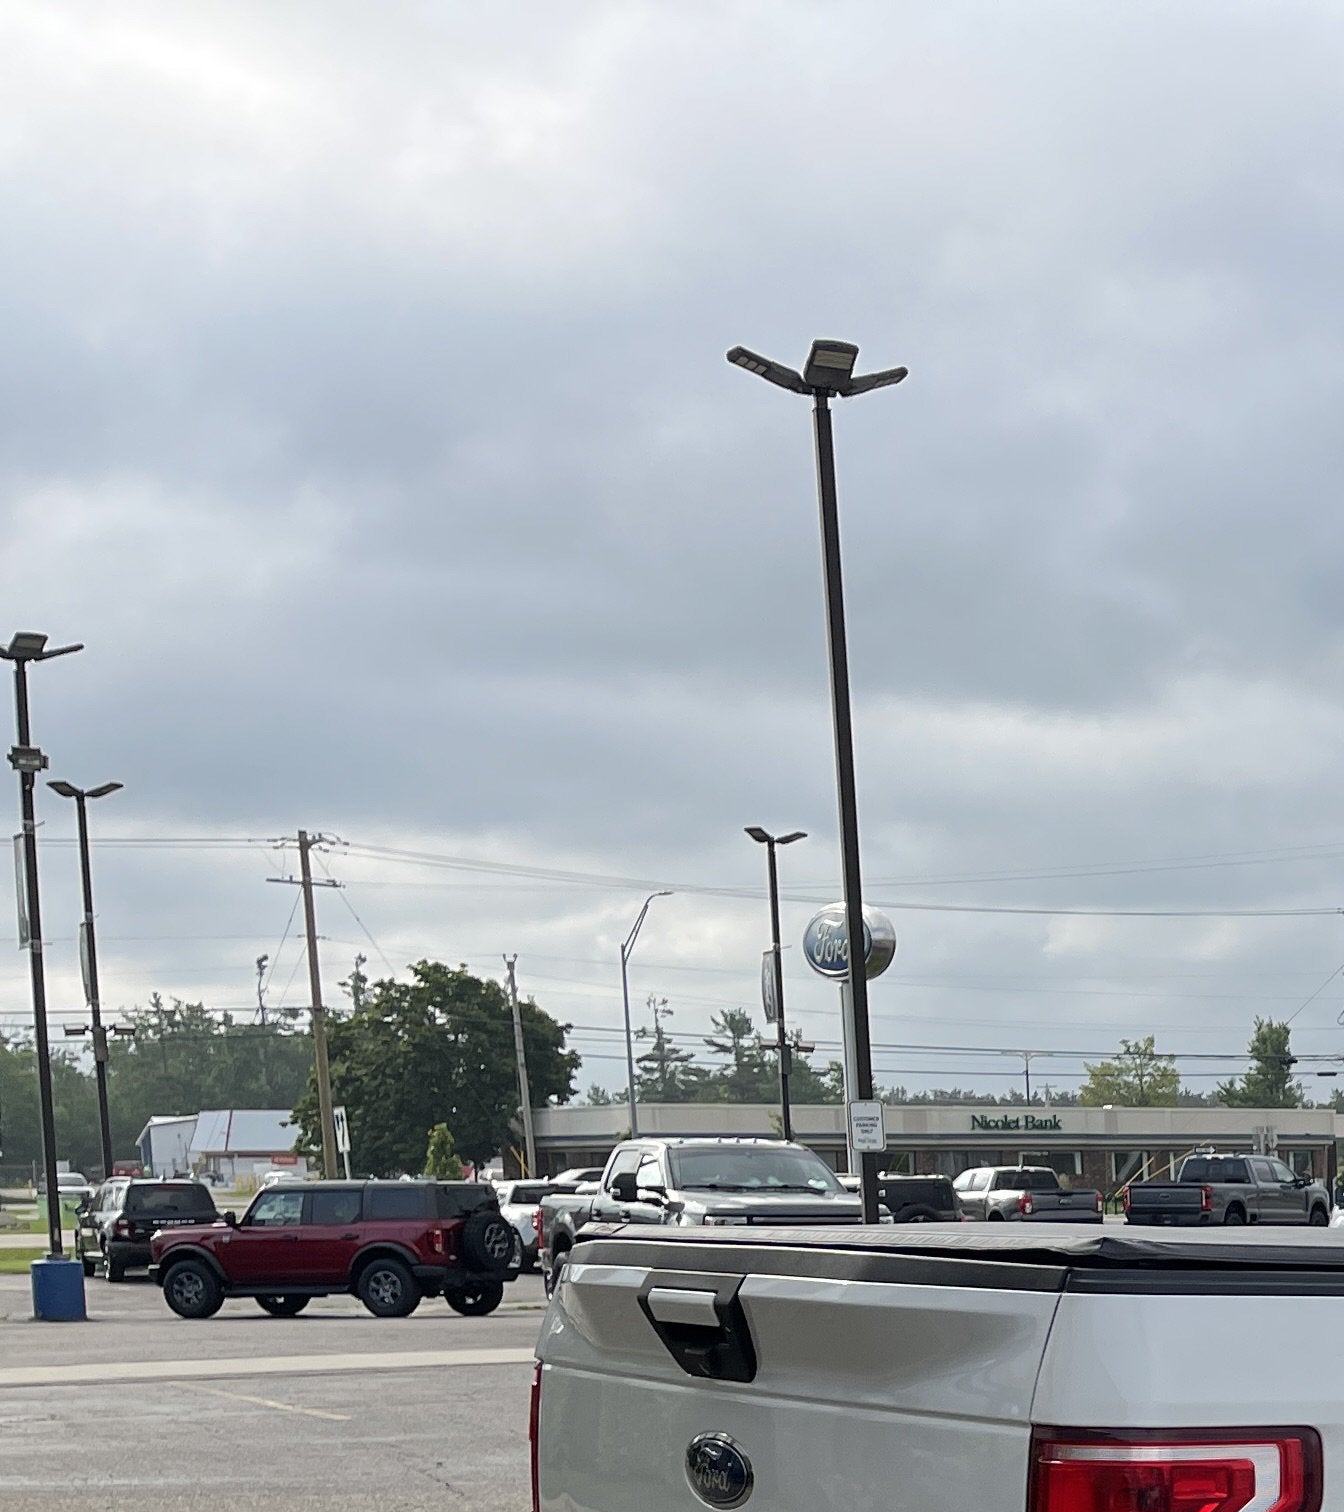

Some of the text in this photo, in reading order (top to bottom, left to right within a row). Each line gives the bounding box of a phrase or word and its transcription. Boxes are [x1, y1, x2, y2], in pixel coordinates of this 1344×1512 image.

[970, 1114, 1063, 1131] Nicolet Bank
[695, 1446, 732, 1492] Ford
